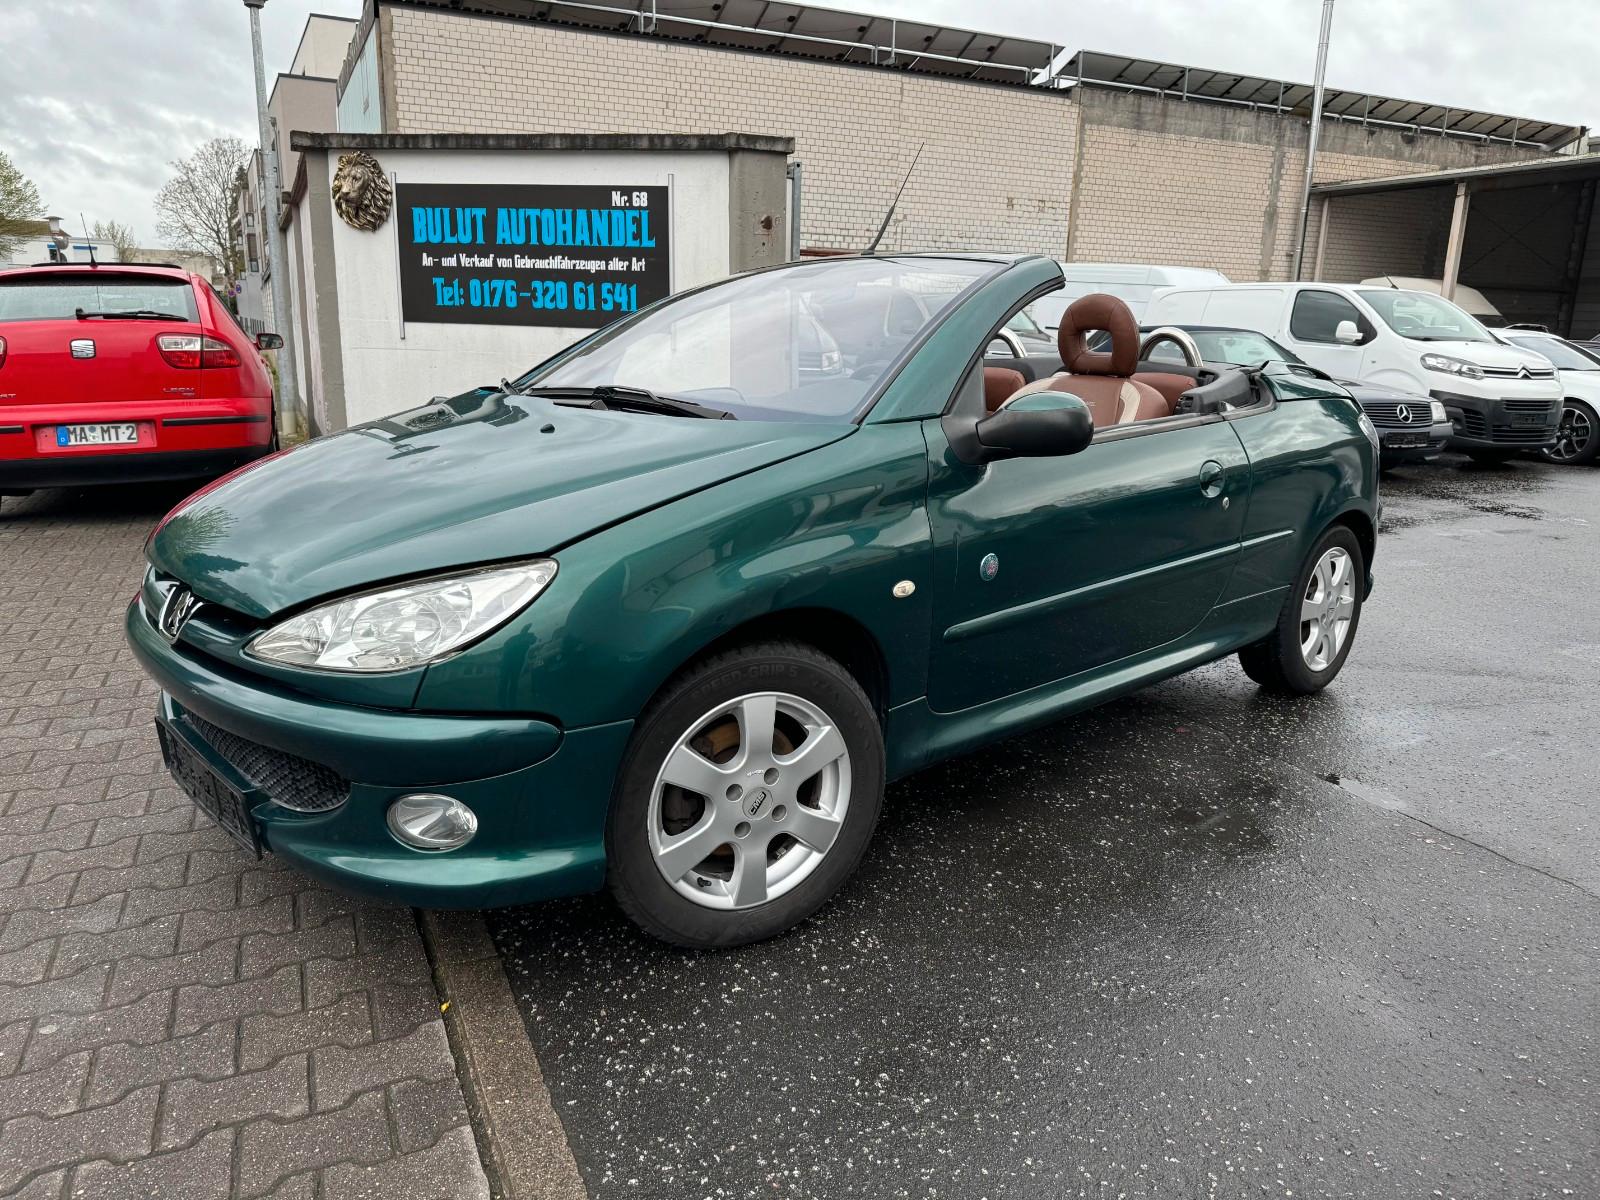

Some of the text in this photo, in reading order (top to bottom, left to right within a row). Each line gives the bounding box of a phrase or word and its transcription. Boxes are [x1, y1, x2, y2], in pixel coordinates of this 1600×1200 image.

[611, 190, 648, 207] Nr. 68
[411, 206, 656, 248] BULUT AUTOHANDEL
[422, 253, 440, 267] An-
[441, 254, 457, 267] und
[459, 253, 495, 268] Verkauf
[497, 257, 513, 268] von
[608, 257, 629, 271] aller
[631, 257, 646, 272] Art
[432, 277, 639, 313] Tel: 0176-320 61 541
[67, 426, 89, 443] MA
[748, 791, 767, 816] CMS
